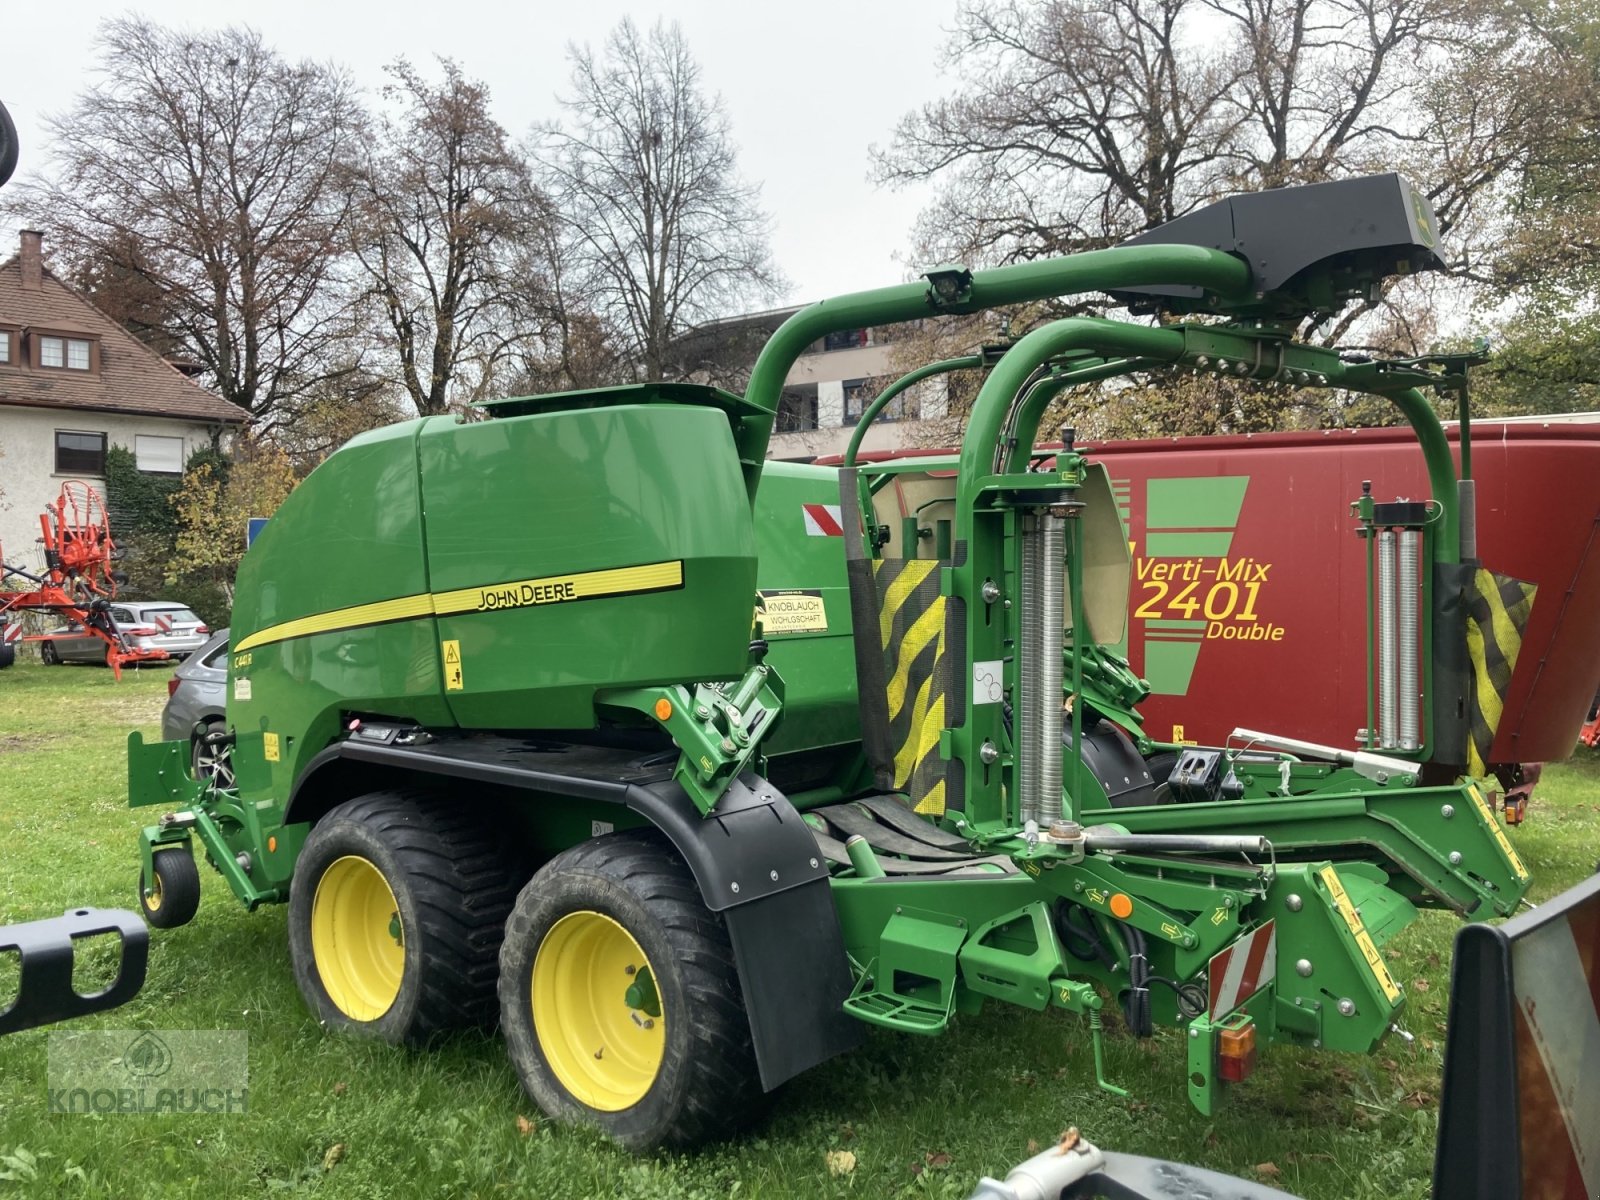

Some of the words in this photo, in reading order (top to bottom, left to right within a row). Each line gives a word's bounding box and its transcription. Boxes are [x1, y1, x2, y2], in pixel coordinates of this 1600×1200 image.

[1136, 557, 1272, 582] Verti-Mix
[477, 589, 518, 609] JOHN
[521, 582, 576, 603] DEERE
[767, 601, 819, 612] KNOBLAUCH
[1134, 580, 1261, 621] 2401
[1206, 621, 1285, 641] Double
